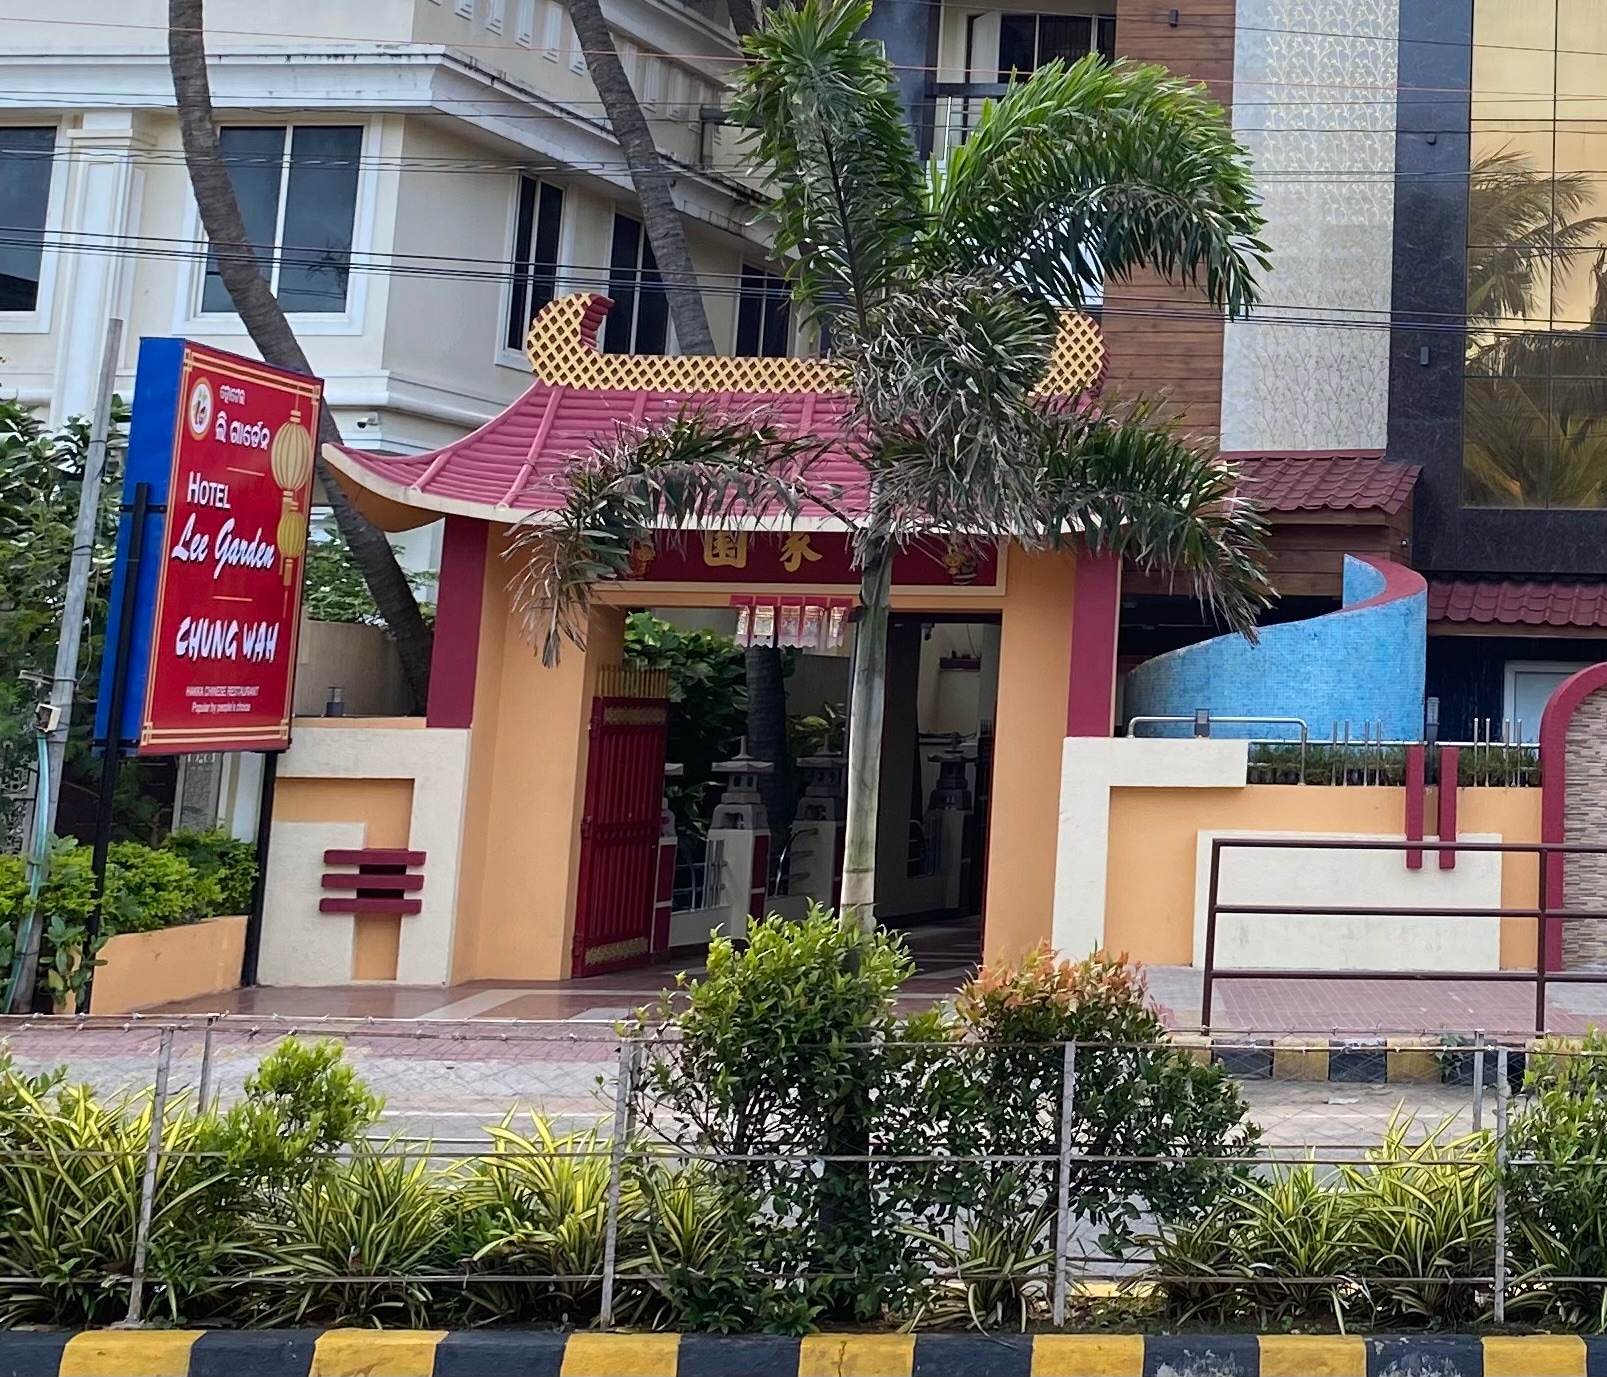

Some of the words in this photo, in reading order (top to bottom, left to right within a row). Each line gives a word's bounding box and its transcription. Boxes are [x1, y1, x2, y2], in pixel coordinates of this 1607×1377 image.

[187, 471, 231, 510] HOTEL
[171, 512, 210, 562] Lee
[213, 517, 275, 580] Garden
[176, 616, 239, 662] CHUNG
[242, 621, 280, 664] WAH
